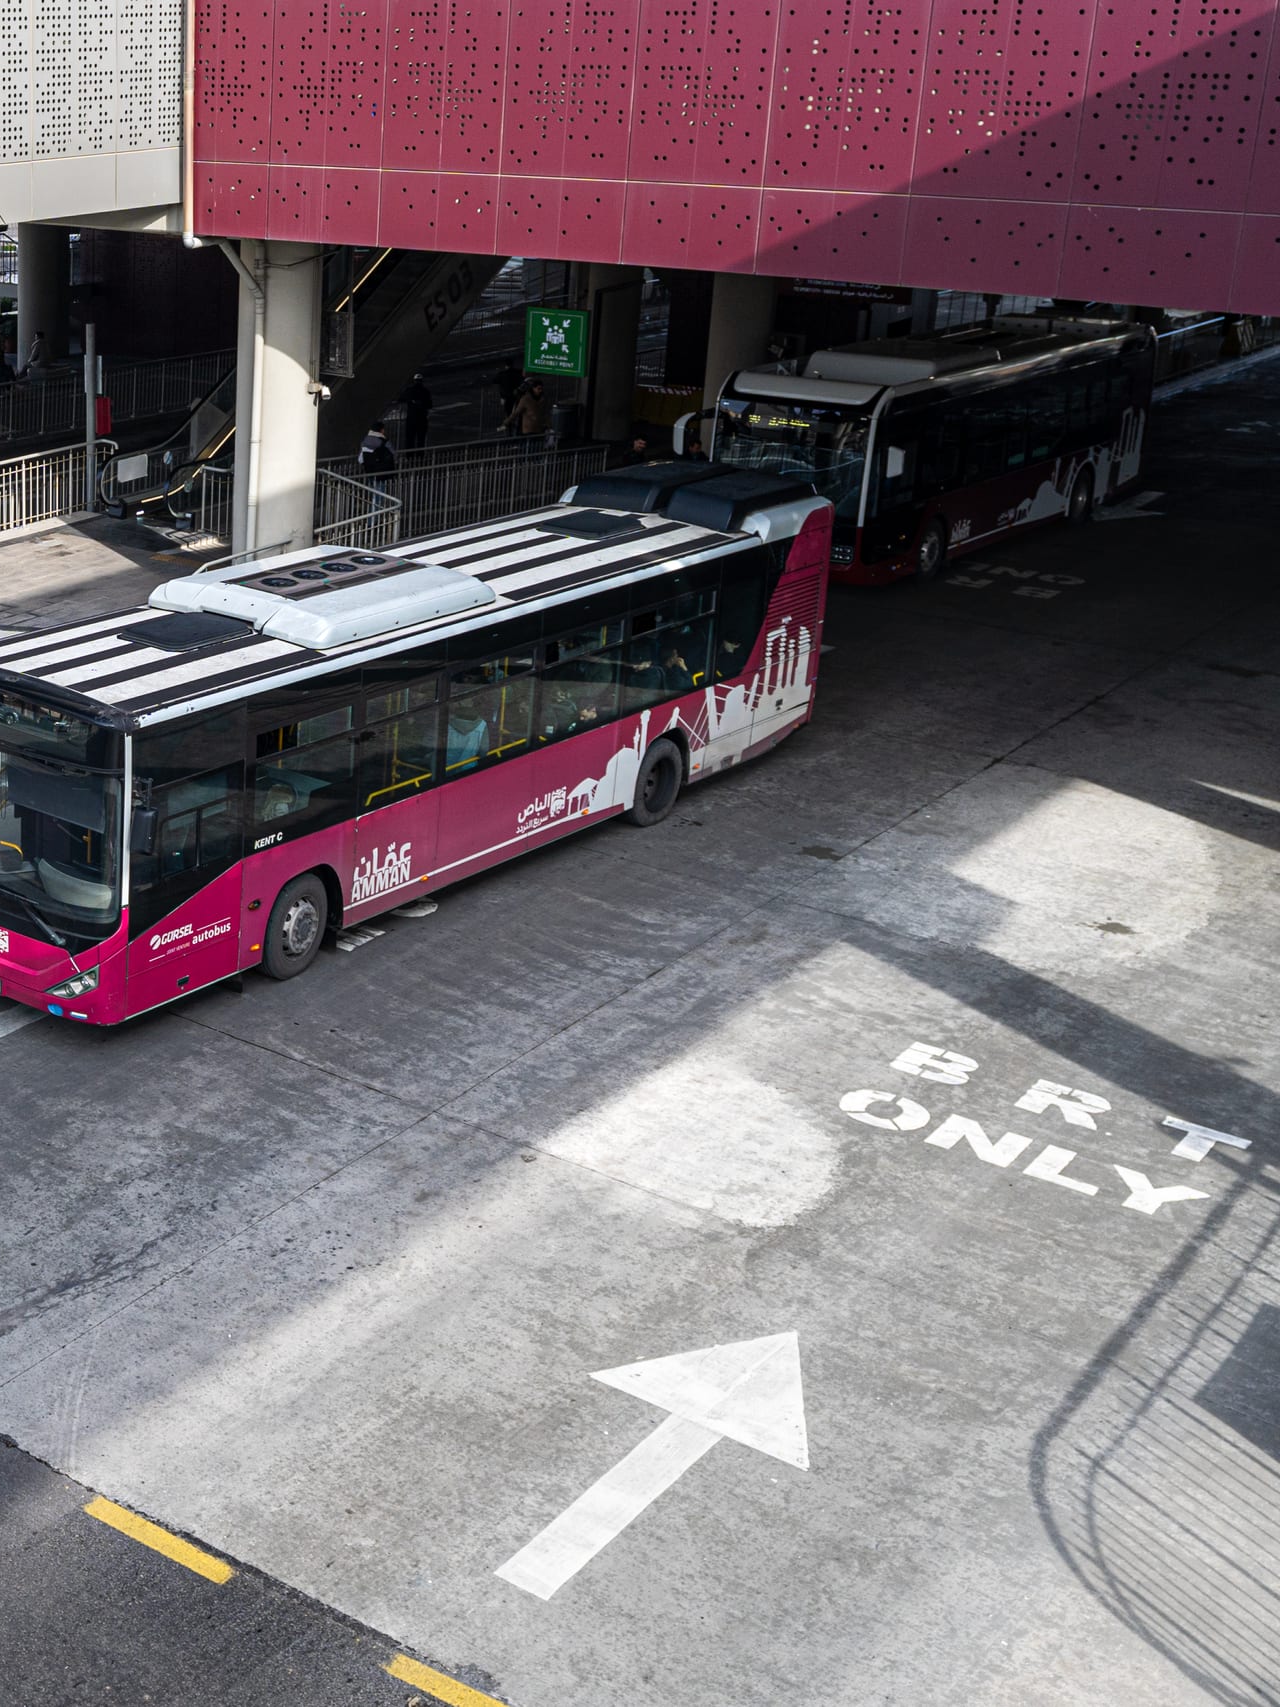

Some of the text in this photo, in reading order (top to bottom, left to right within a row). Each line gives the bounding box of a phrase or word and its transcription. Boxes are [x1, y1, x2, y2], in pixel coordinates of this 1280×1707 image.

[517, 793, 550, 823] الباص
[254, 832, 283, 850] KENT C
[351, 860, 411, 903] AMMAN
[192, 922, 231, 945] autobus
[838, 1088, 1211, 1215] ONLY
